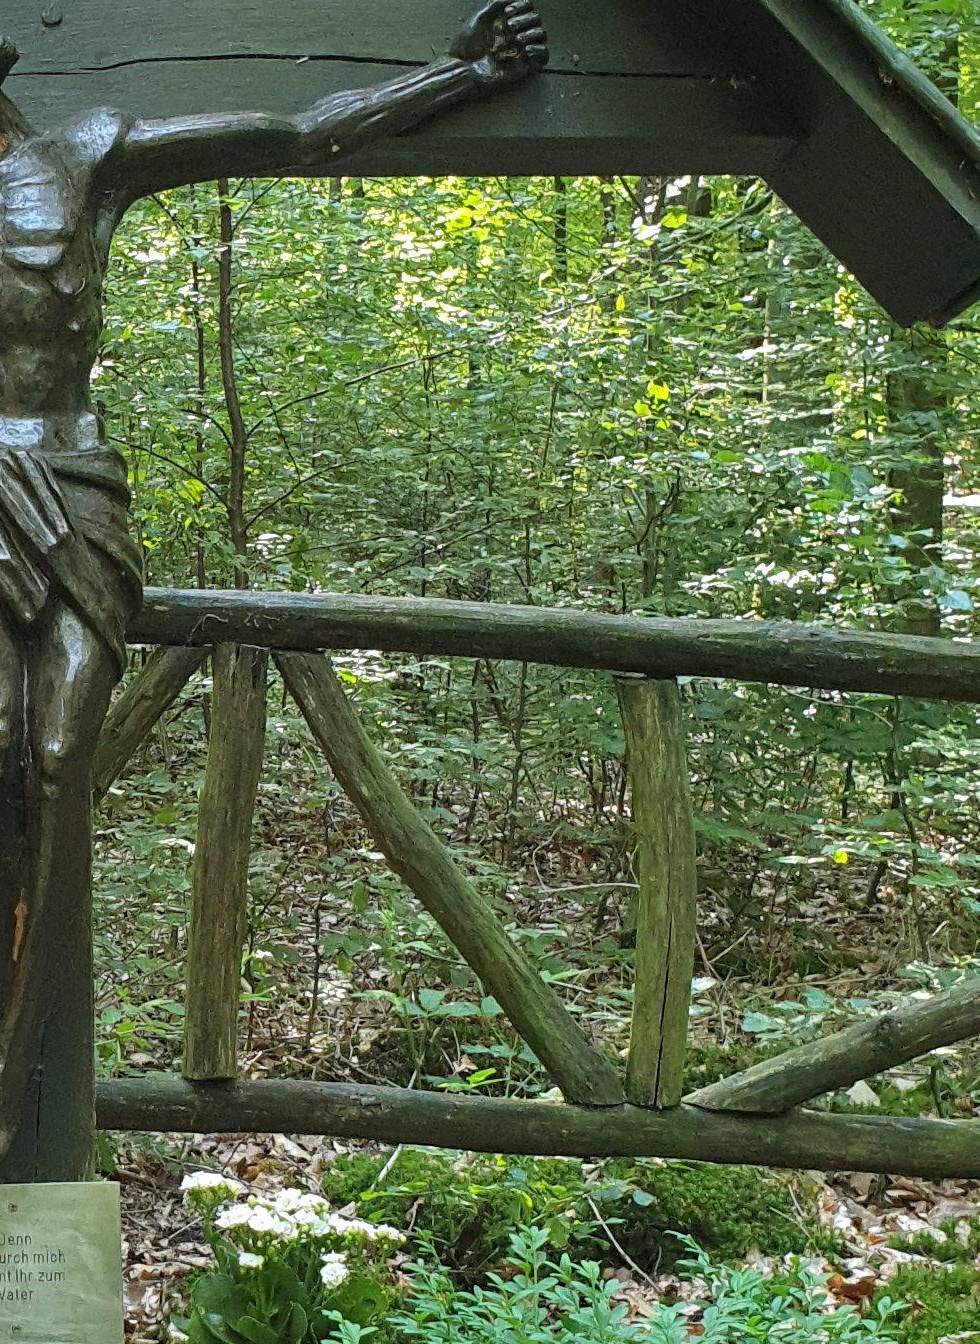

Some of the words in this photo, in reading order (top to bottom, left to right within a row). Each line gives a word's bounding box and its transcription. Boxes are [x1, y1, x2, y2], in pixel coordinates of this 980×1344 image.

[33, 1249, 66, 1264] mich
[15, 1268, 33, 1282] Ihr
[37, 1271, 65, 1282] zum
